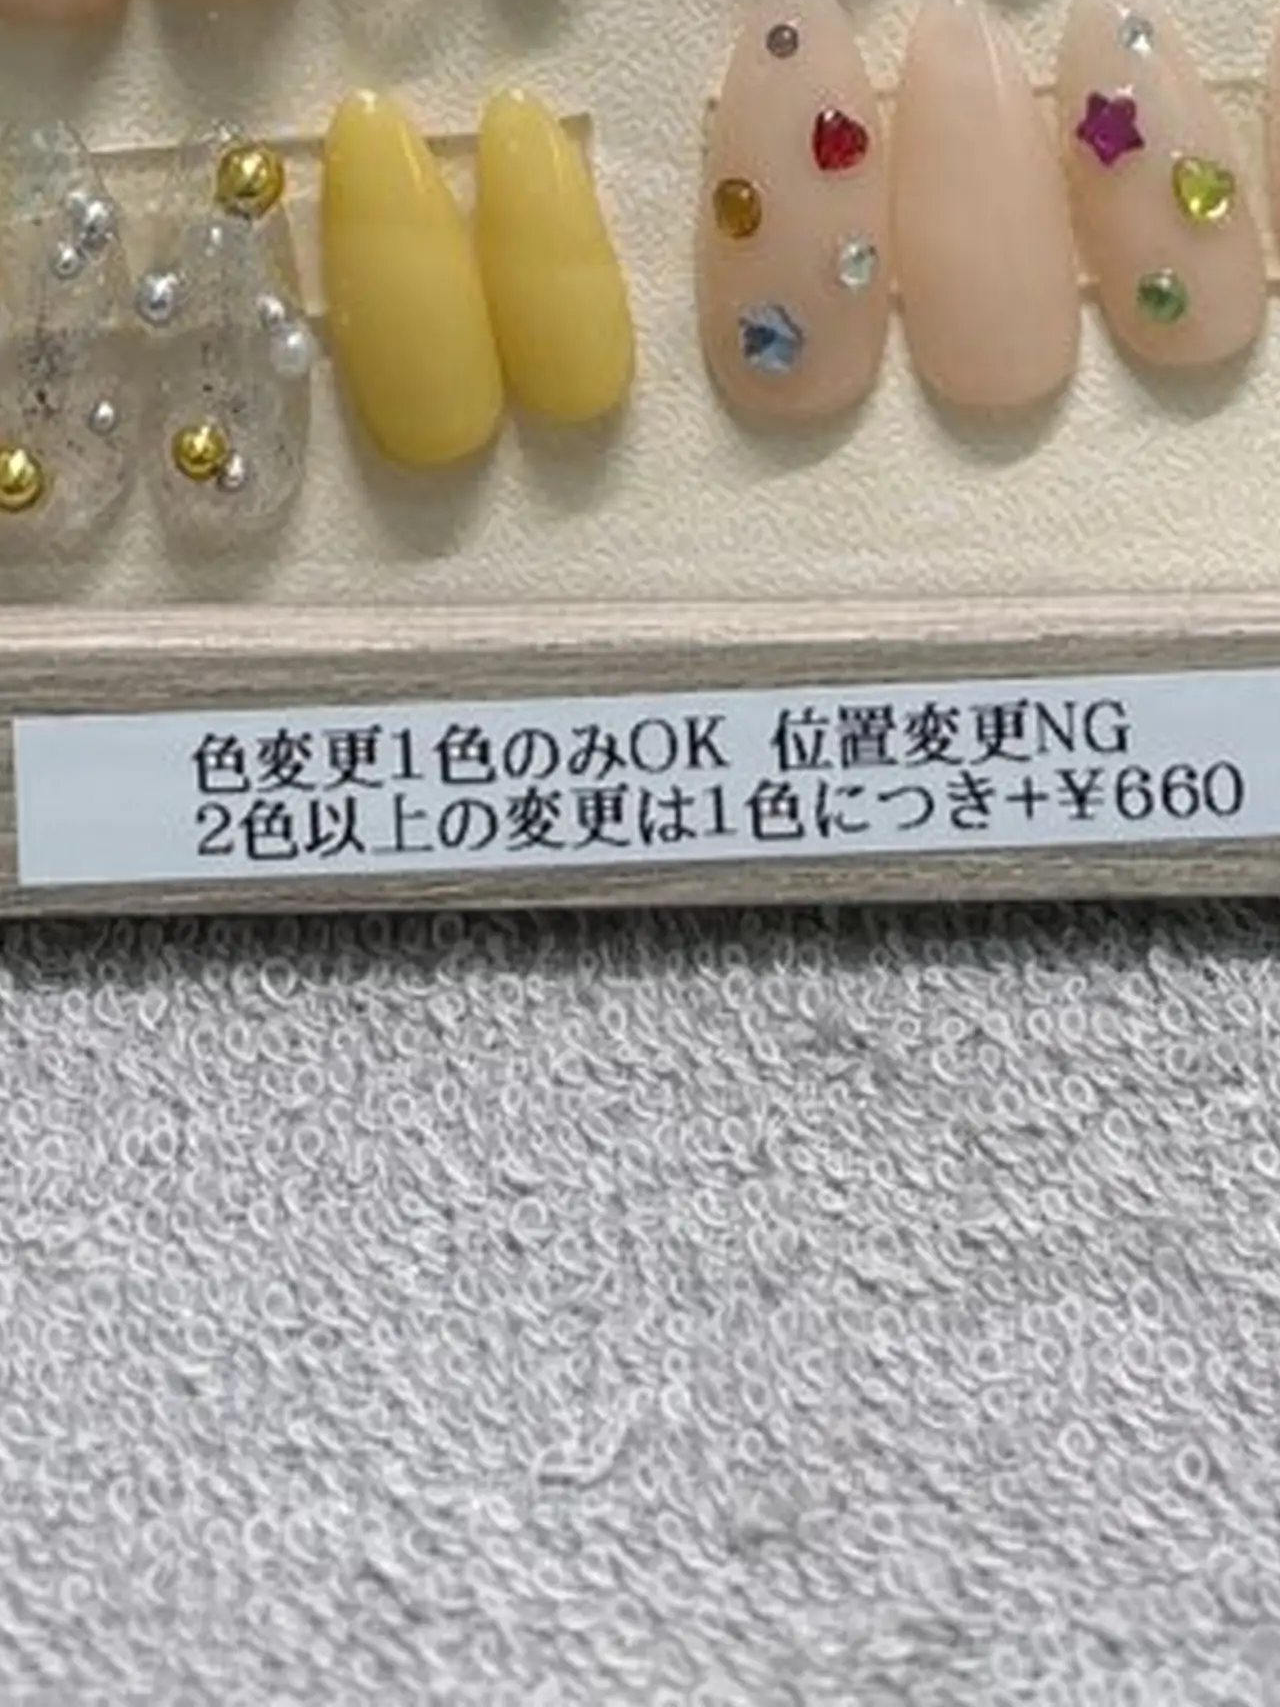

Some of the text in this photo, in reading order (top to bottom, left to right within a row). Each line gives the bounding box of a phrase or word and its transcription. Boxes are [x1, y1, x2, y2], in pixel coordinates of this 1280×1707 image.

[193, 700, 1131, 794] 色変更1色のみOK 位置変更NG
[195, 760, 1245, 860] 2色以上の変更は1色につき+¥660
